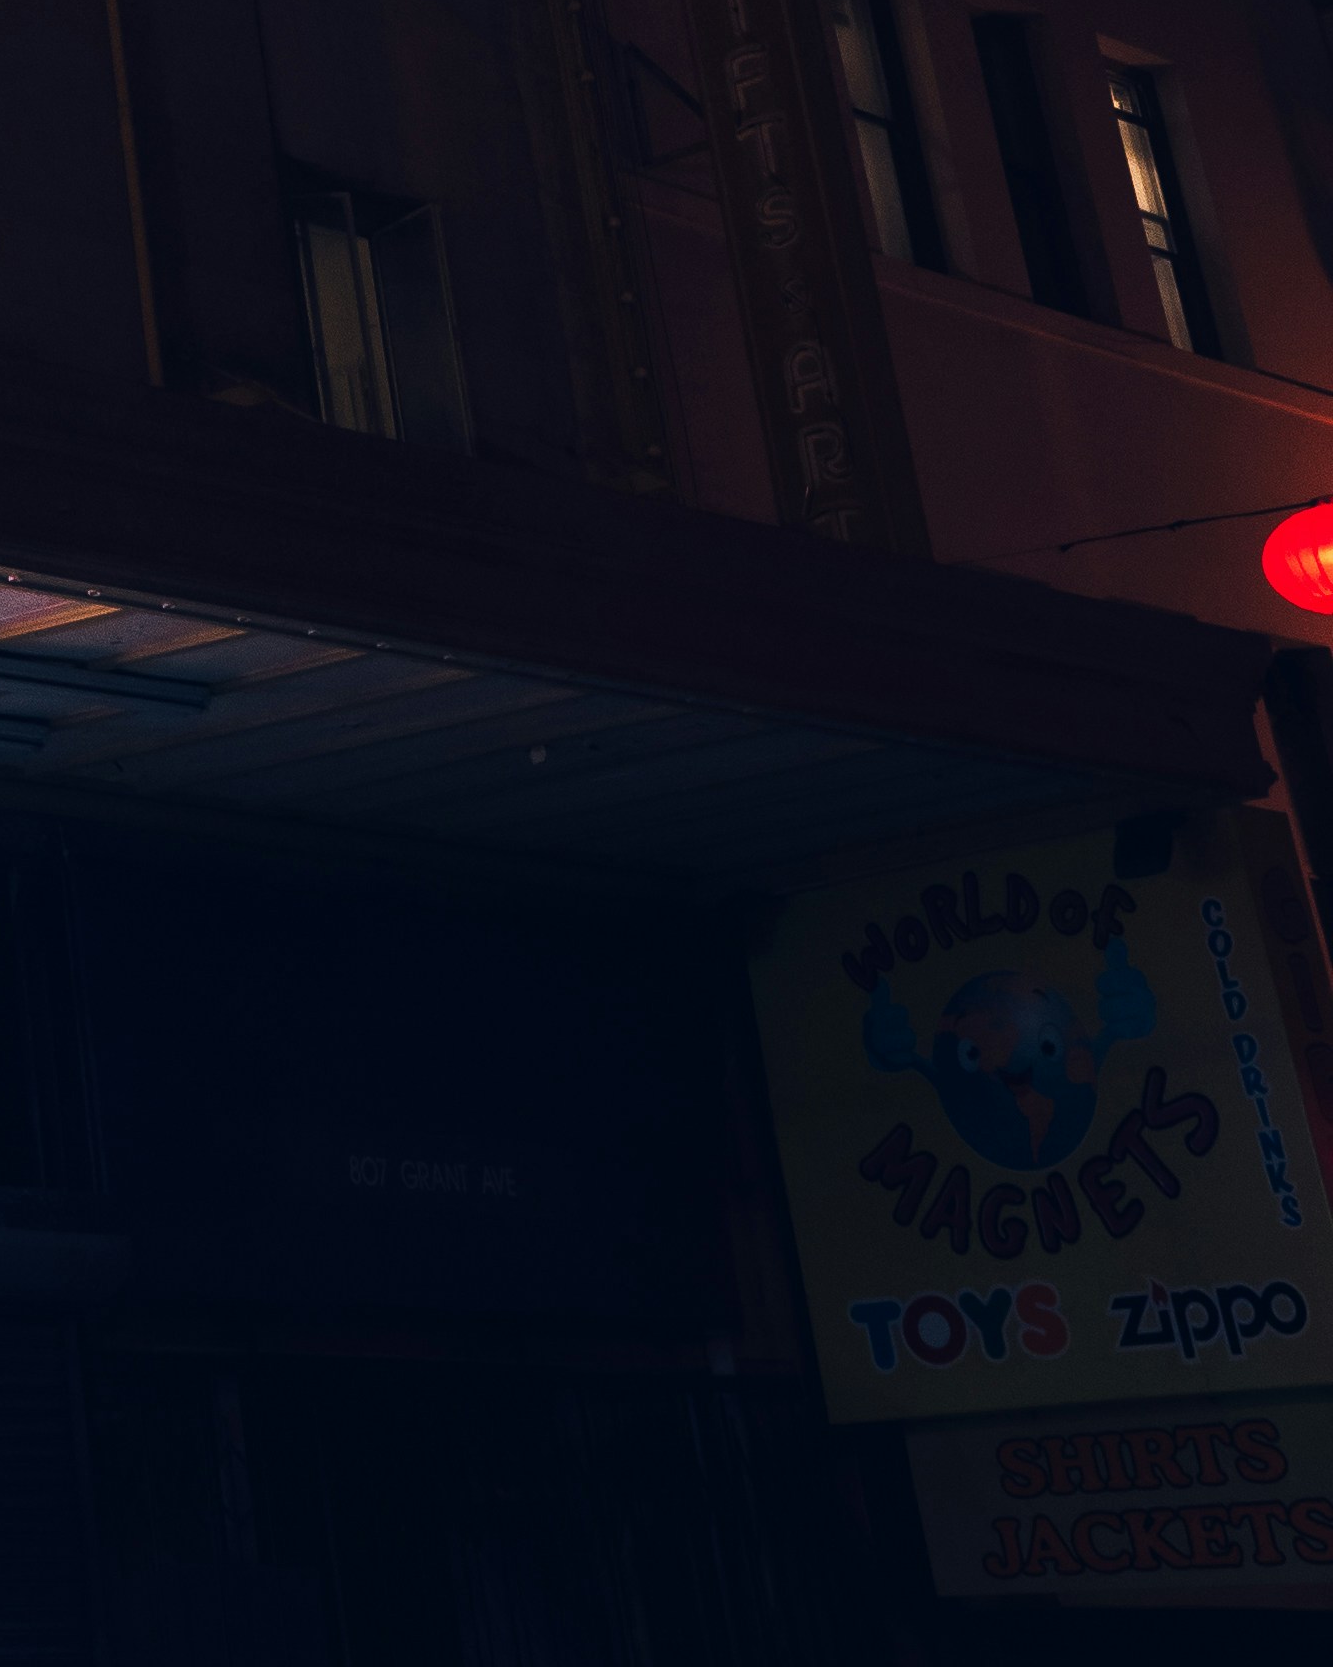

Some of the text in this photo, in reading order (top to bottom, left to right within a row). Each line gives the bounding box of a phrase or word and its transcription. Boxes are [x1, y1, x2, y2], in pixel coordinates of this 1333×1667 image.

[1201, 897, 1247, 1021] COLD
[1233, 1033, 1303, 1228] DRINKS
[400, 1159, 468, 1194] GRANT
[859, 1067, 1221, 1260] MAGNETS
[850, 1283, 1069, 1370] TOYS
[996, 1419, 1289, 1499] SHIRTS
[983, 1498, 1333, 1579] JACKETS
